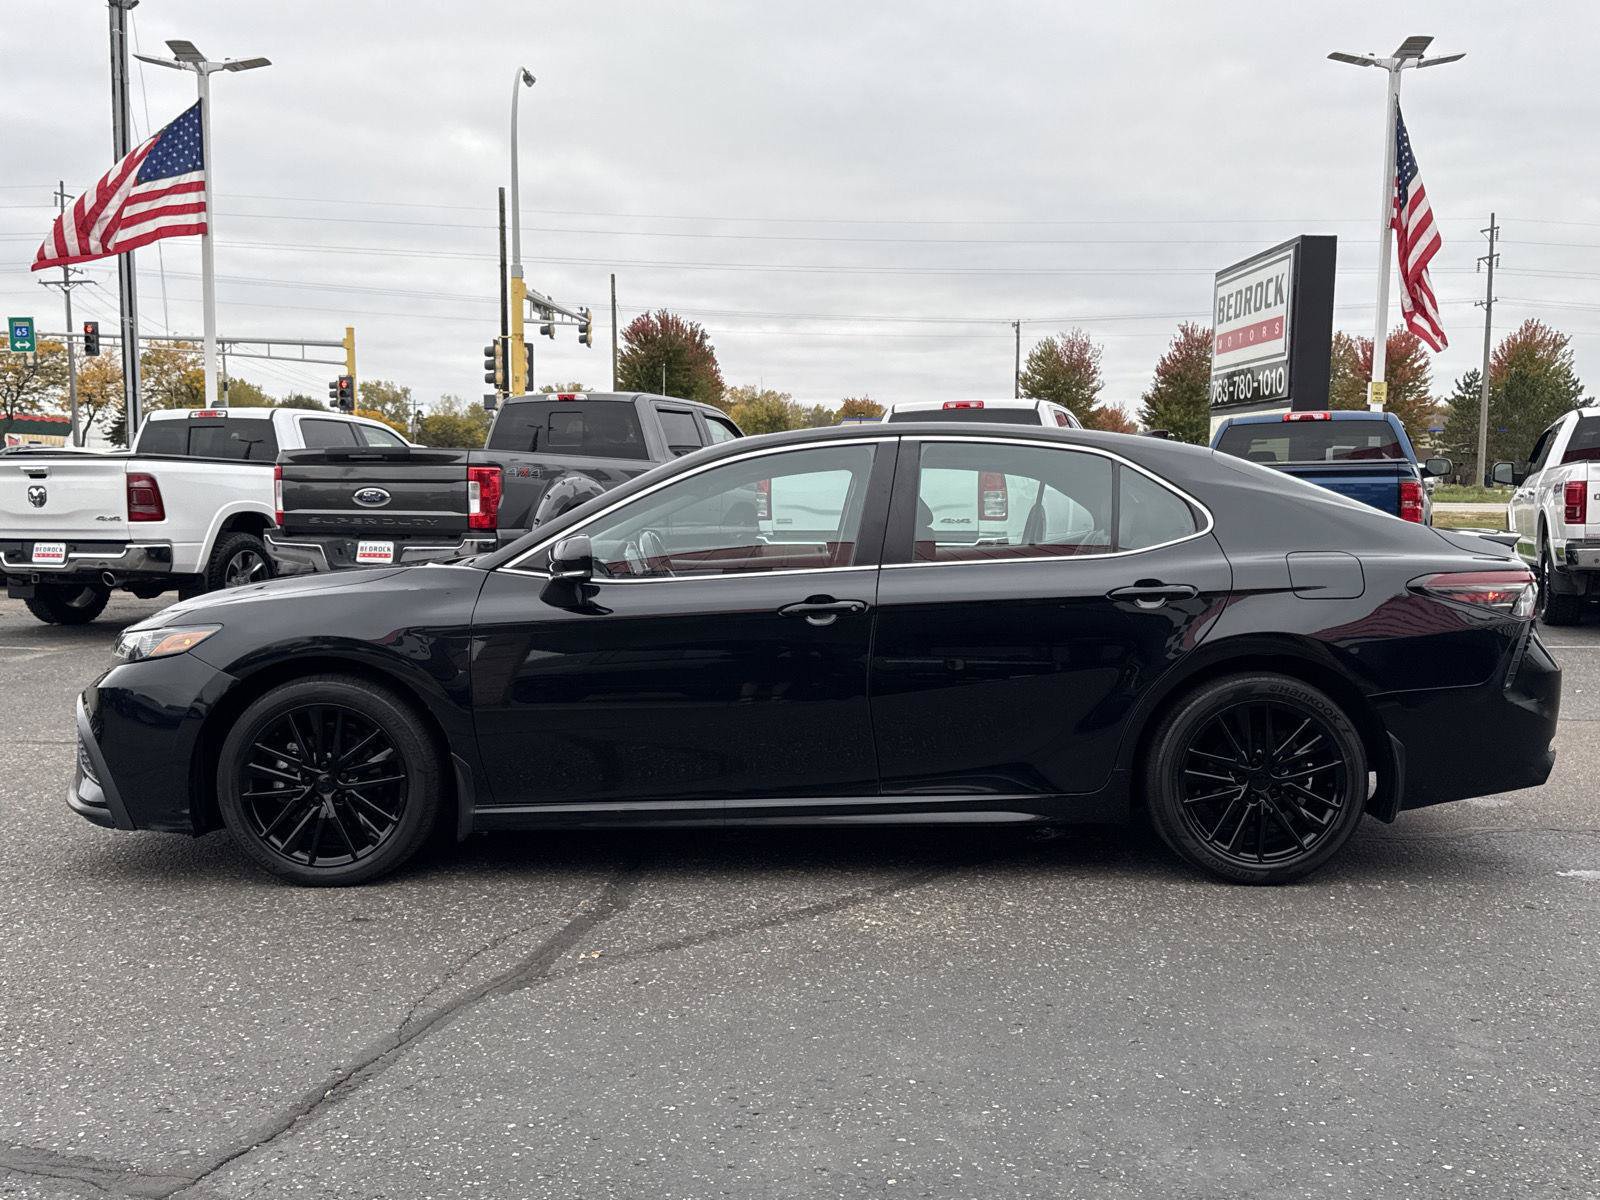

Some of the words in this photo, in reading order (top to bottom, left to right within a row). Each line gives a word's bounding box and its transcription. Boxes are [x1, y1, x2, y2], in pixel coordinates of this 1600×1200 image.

[1218, 274, 1284, 324] BEDROCK
[16, 328, 27, 336] 65
[1219, 322, 1280, 349] MOTORS
[1212, 367, 1284, 403] 763-780-1010
[360, 545, 392, 553] BEDROCK
